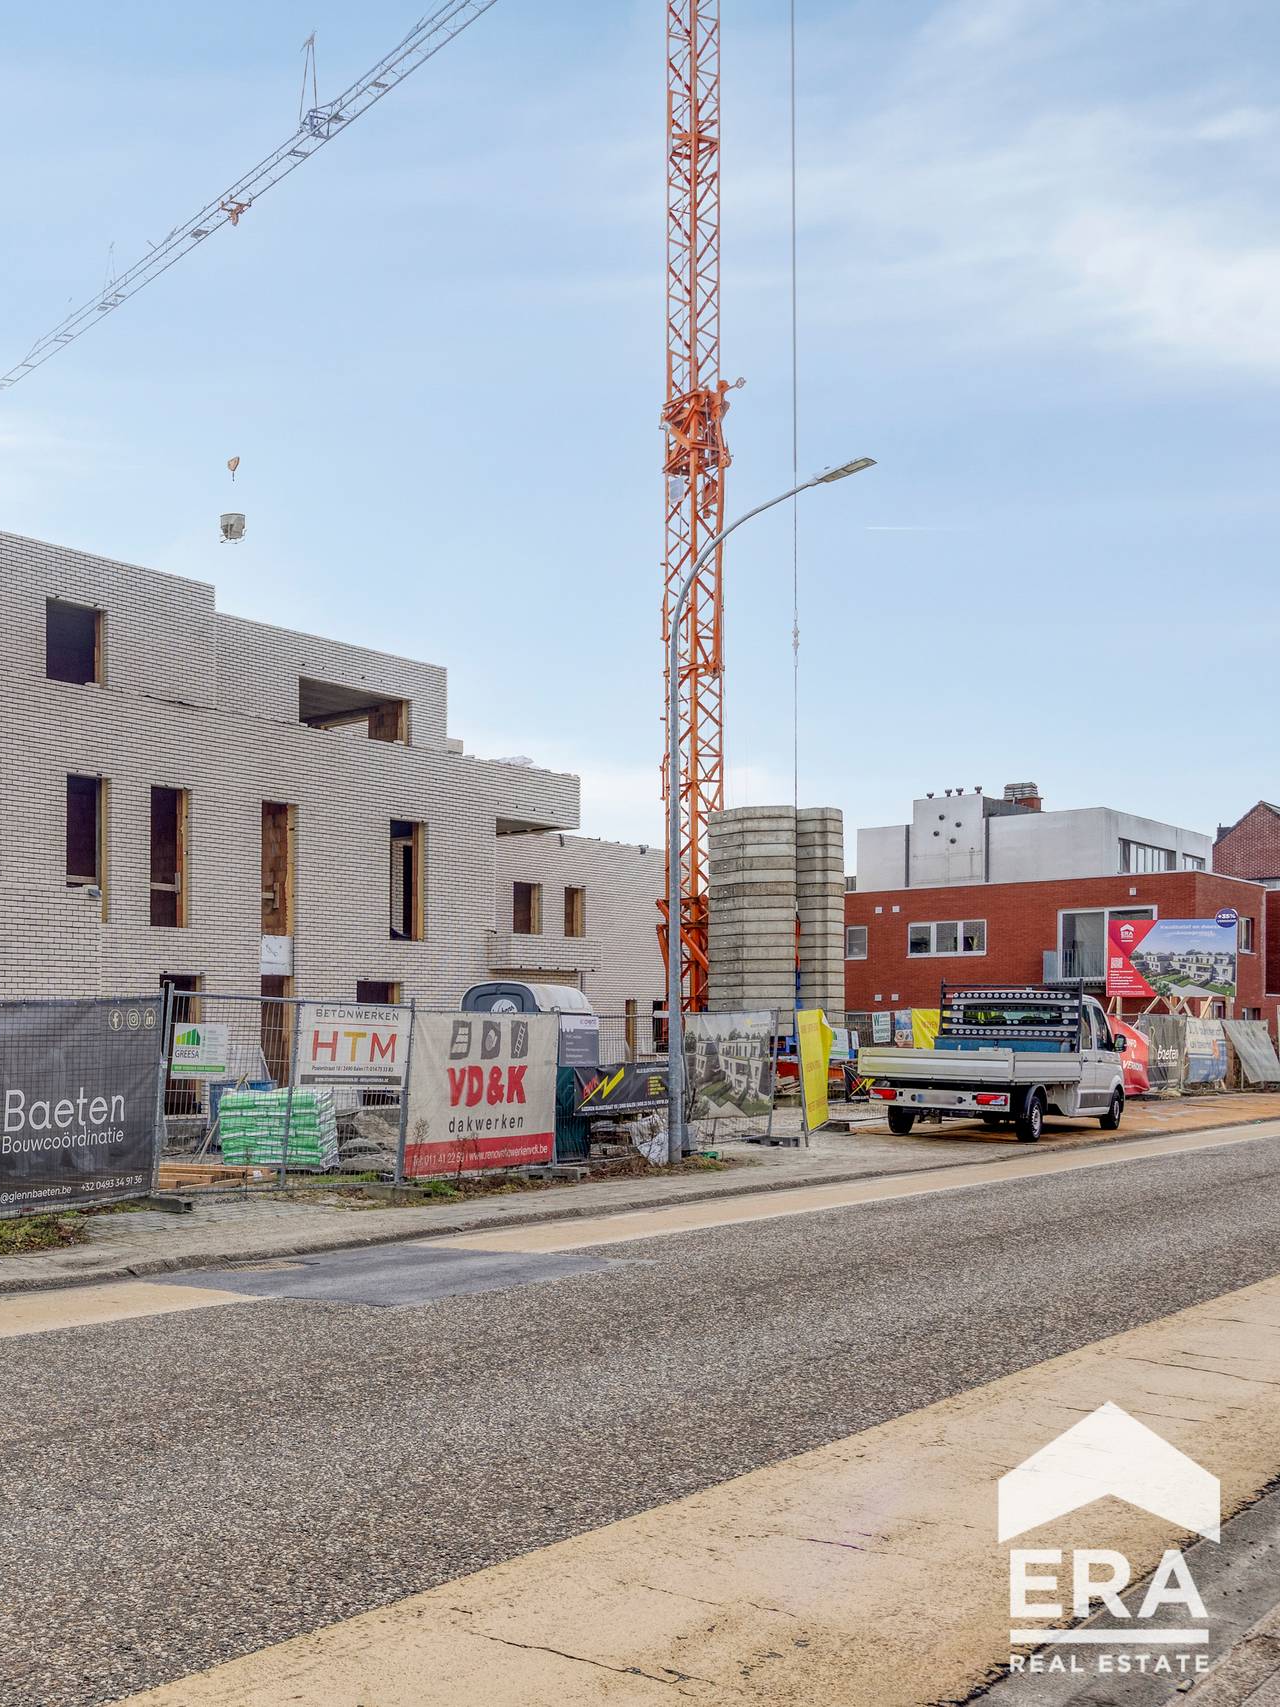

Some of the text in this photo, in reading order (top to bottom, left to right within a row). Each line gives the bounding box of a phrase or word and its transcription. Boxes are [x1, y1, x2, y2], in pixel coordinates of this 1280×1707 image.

[315, 1008, 399, 1021] BETONWERKEN
[174, 1049, 200, 1059] GREESA
[312, 1030, 397, 1063] HTM
[447, 1065, 528, 1107] VD&K
[4, 1087, 125, 1132] Baeten
[448, 1114, 524, 1133] dakwerken
[2, 1125, 124, 1154] Bouwcoördinatie
[81, 1181, 95, 1192] +32
[96, 1178, 114, 1191] 0493
